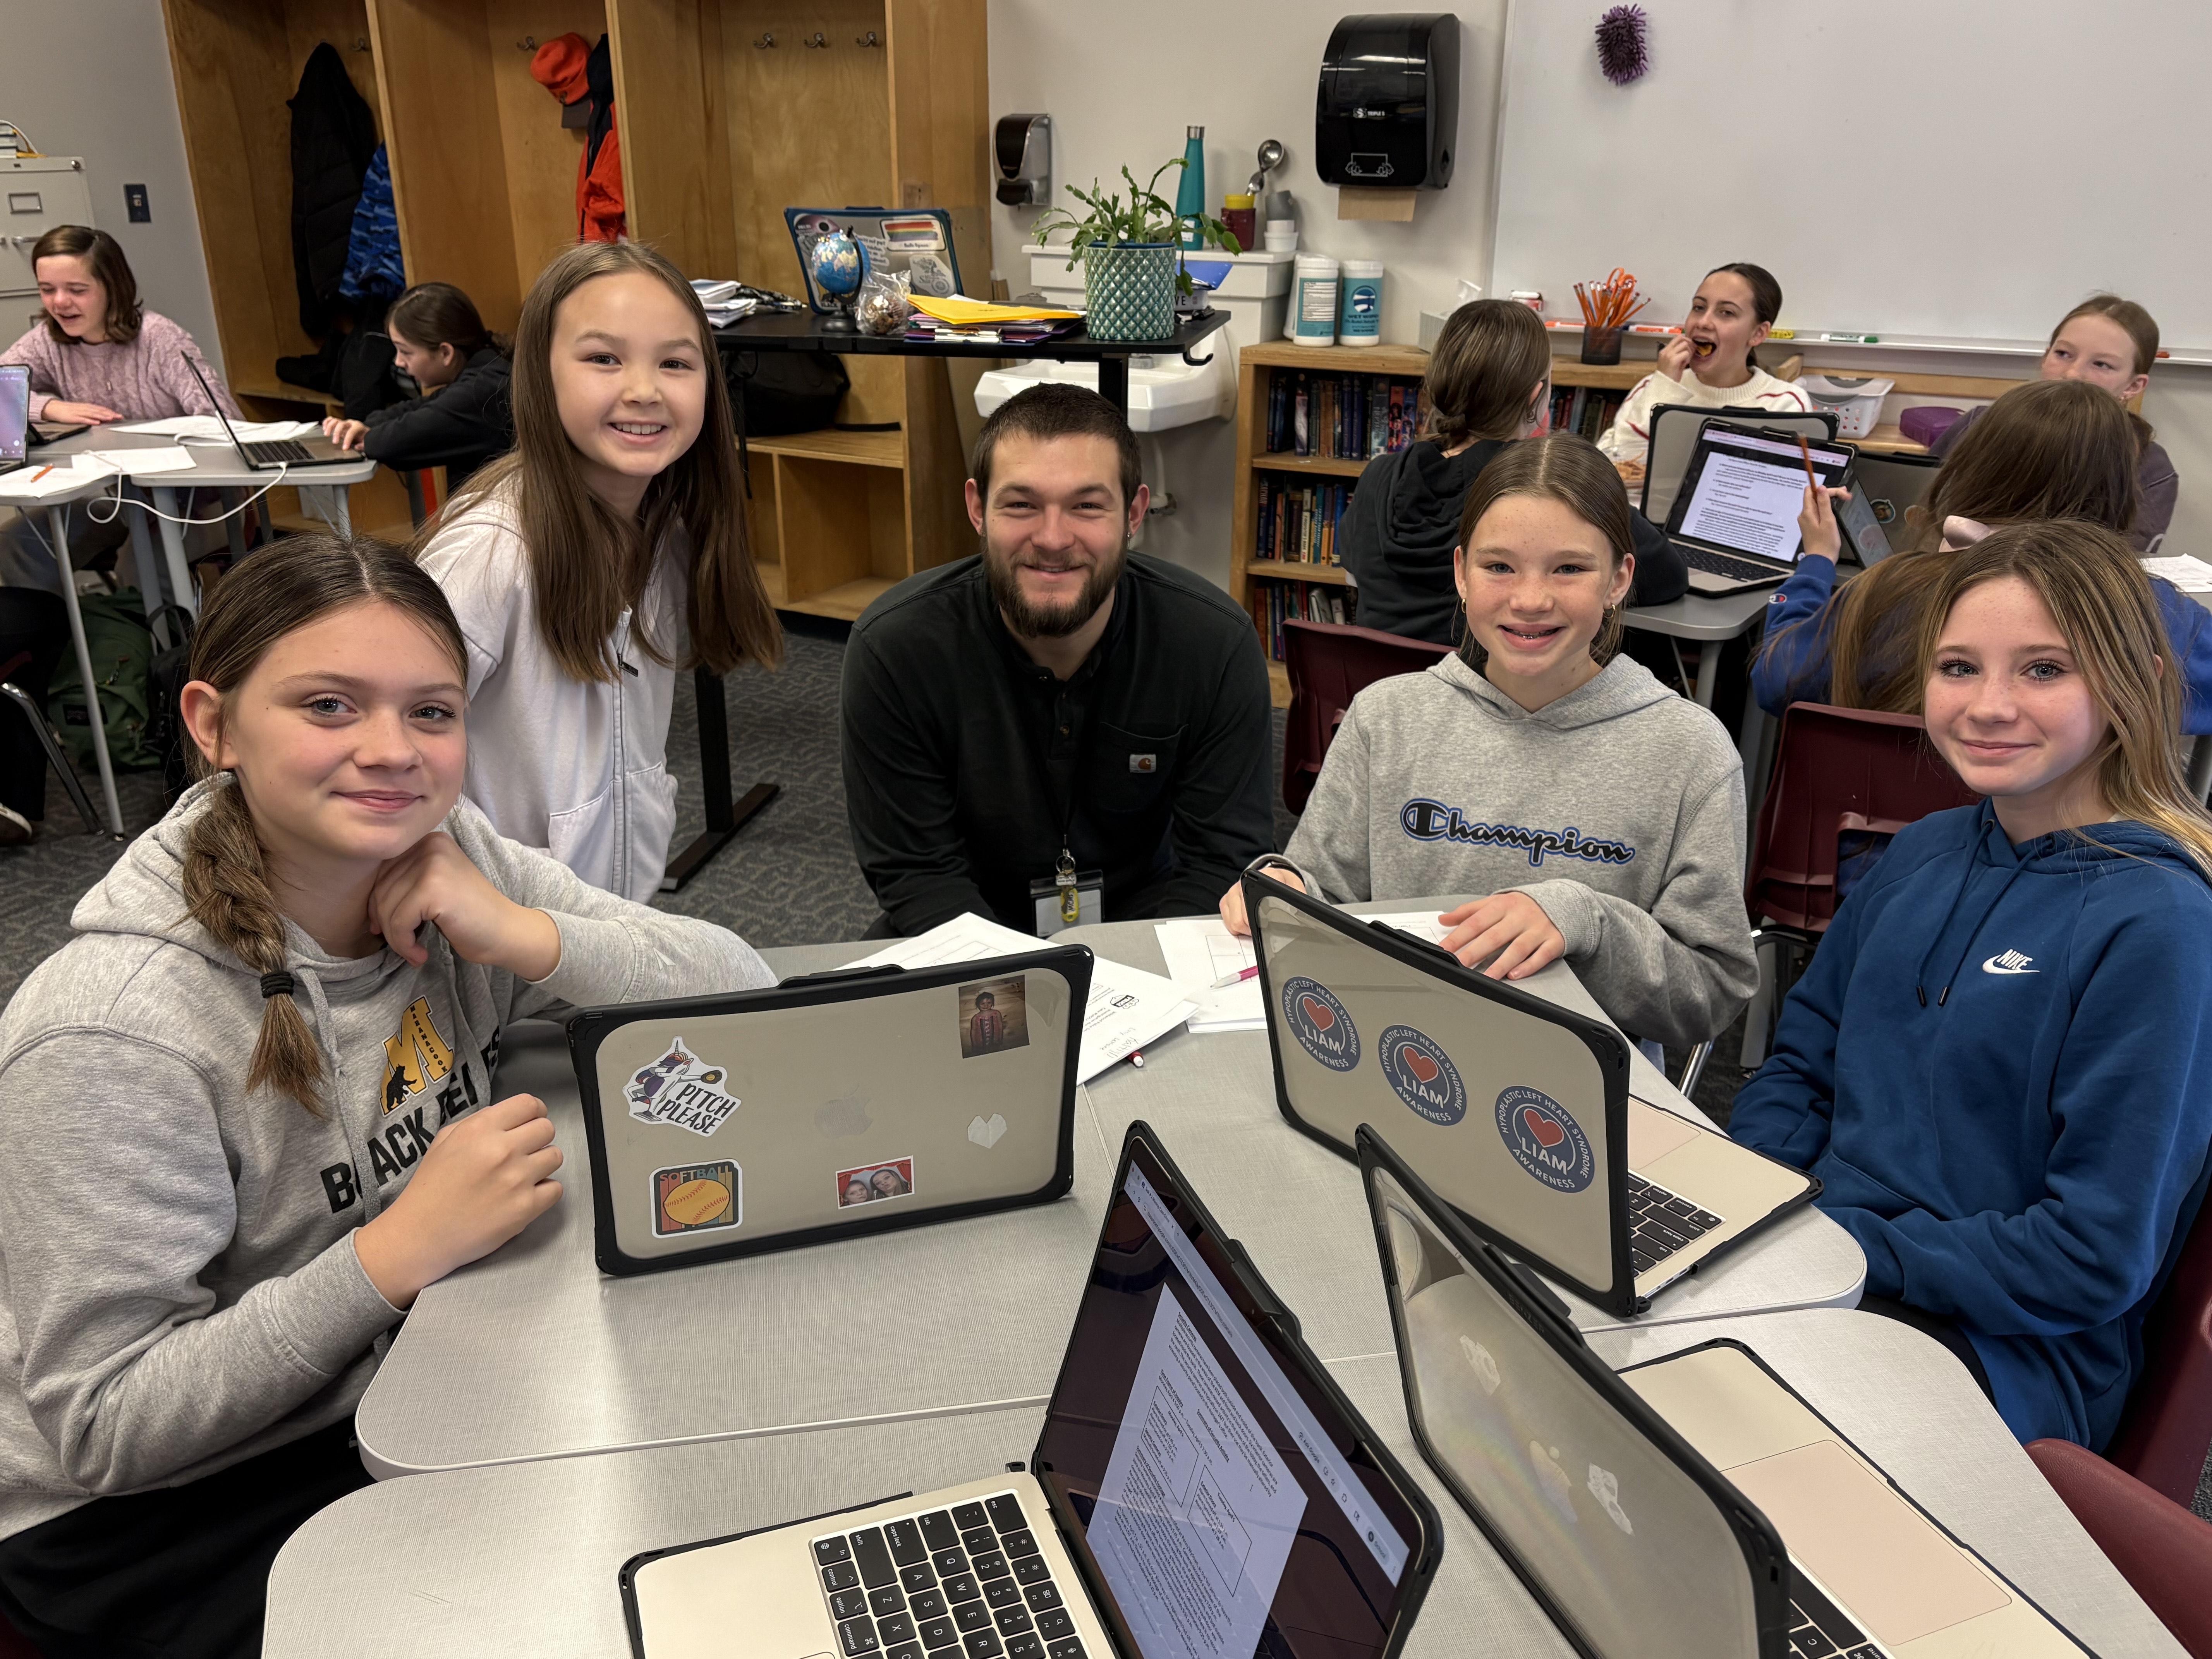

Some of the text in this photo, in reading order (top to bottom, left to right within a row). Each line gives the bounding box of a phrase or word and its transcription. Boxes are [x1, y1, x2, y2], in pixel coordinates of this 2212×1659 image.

[1401, 798, 1635, 867] Champion
[1996, 949, 2033, 970] NIKE
[1284, 980, 1358, 1057] HYPOPLASTIC LEFT HEART SYNDROME
[410, 1005, 448, 1072] MARANACOOK
[1299, 1036, 1349, 1068] AWARENESS
[1304, 1024, 1342, 1056] LIAM
[1380, 1028, 1464, 1112] HYPOPLASTIC LEFT HEART SYNDROME
[675, 1083, 736, 1118] PITCH
[1395, 1085, 1452, 1122] AWARENESS
[1402, 1074, 1444, 1109] LIAM
[656, 1099, 722, 1134] PLEASE
[1499, 1090, 1591, 1179] HYPOPLASTIC LEFT HEART SYNDROME
[320, 1107, 436, 1214] BACK
[1511, 1148, 1576, 1190] AWARENESS
[1520, 1136, 1568, 1176] LIAM
[659, 1165, 733, 1183] SOFTBALL
[1653, 1187, 1667, 1196] option
[1676, 1199, 1692, 1209] control
[1178, 1312, 1196, 1342] Security Cameras
[855, 1534, 864, 1546] shift
[890, 1525, 898, 1537] caps
[827, 1568, 838, 1586] control
[956, 1583, 967, 1592] W
[836, 1596, 845, 1614] option
[843, 1623, 857, 1650] command
